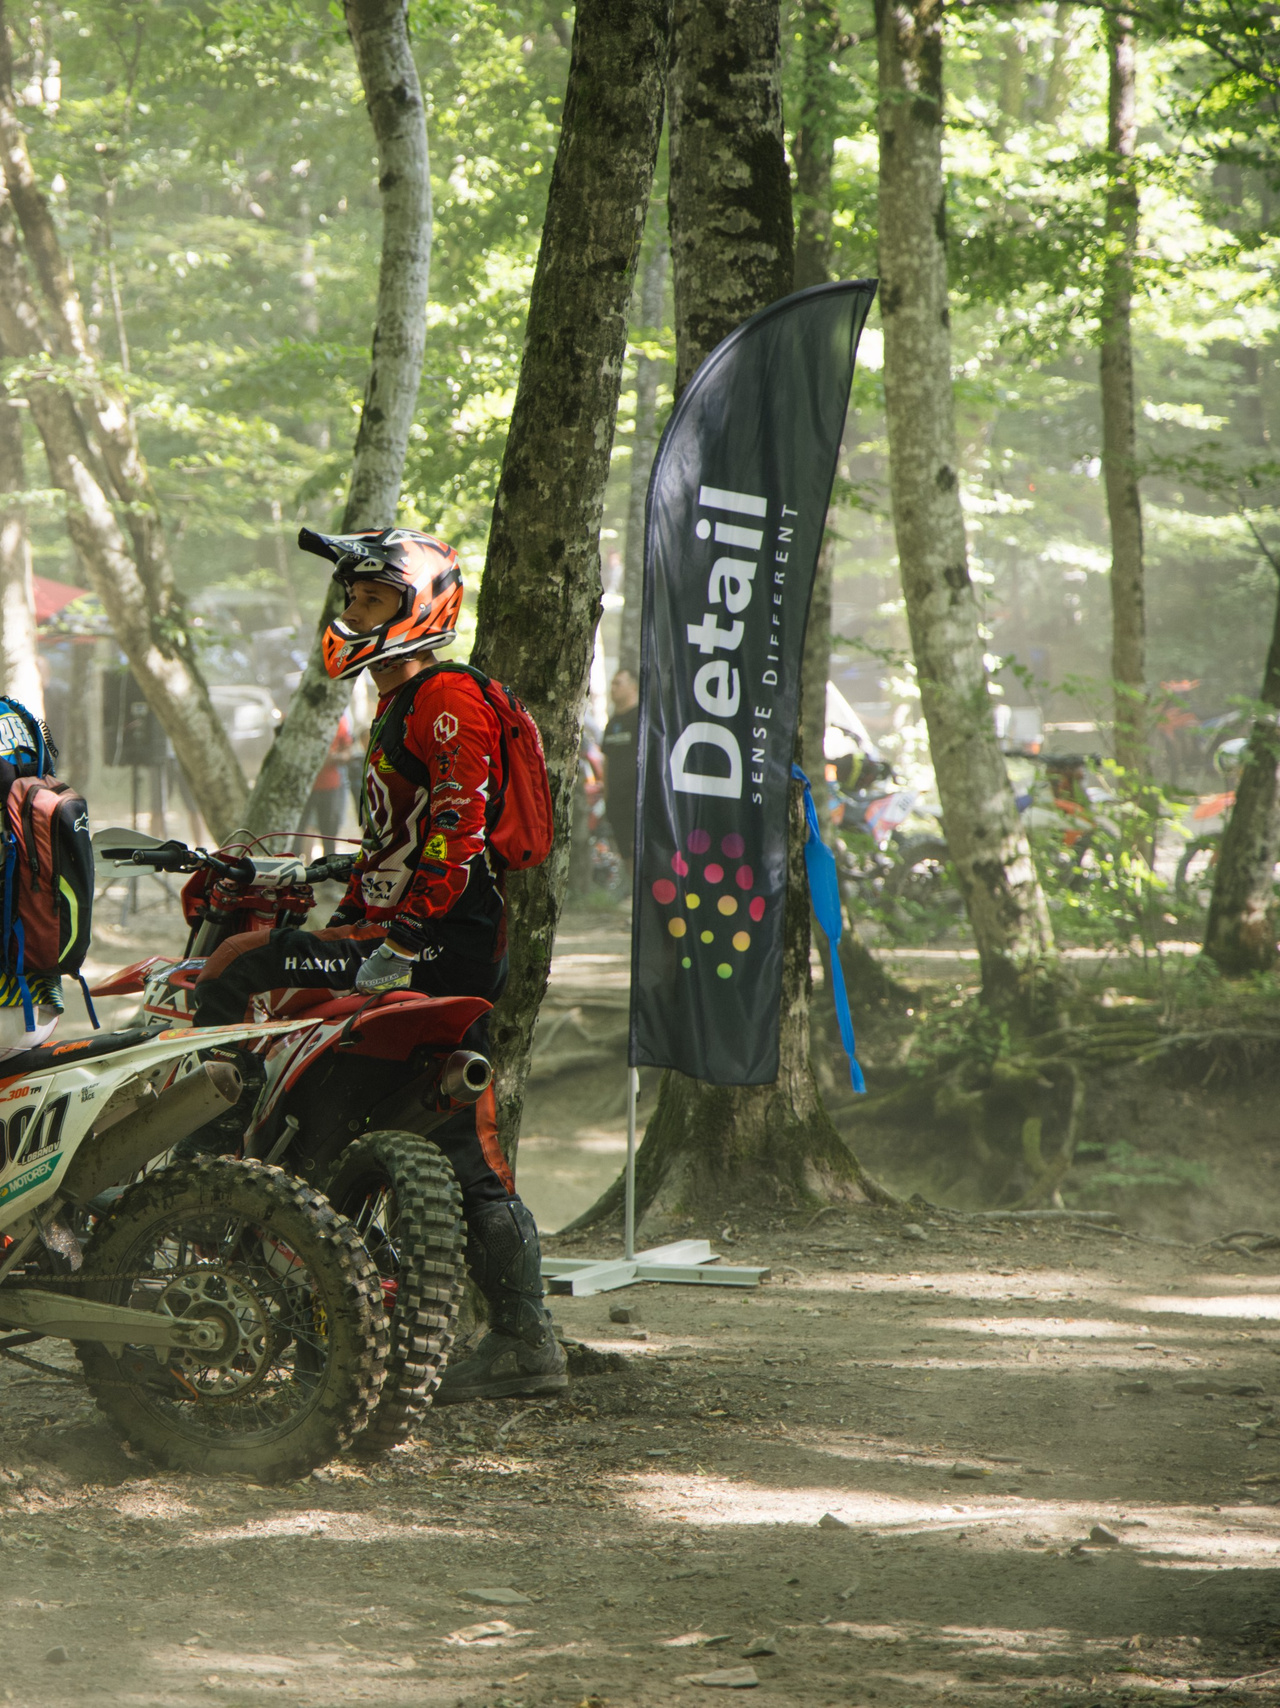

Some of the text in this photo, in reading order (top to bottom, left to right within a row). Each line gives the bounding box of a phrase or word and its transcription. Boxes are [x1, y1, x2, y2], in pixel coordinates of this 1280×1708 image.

[670, 485, 767, 798] Detail
[751, 504, 798, 804] SENSE DIFFERENT
[284, 957, 350, 973] HASKY
[7, 1086, 30, 1101] 300
[8, 1161, 52, 1193] MOTOREX
